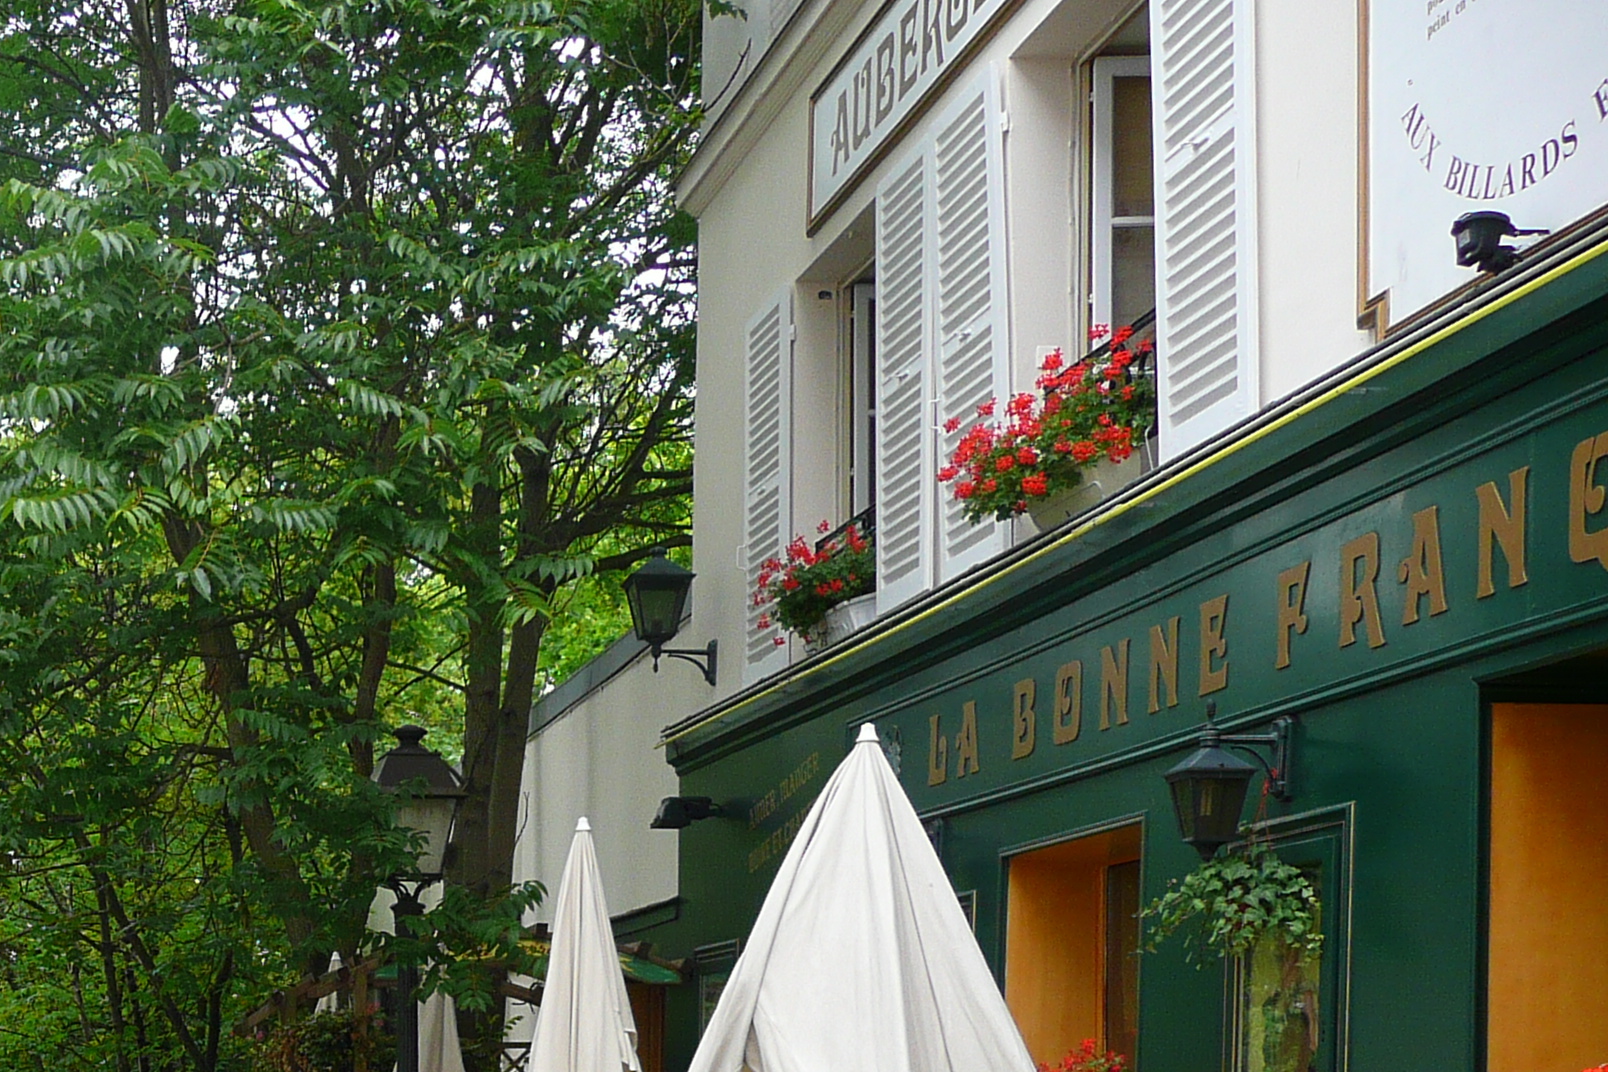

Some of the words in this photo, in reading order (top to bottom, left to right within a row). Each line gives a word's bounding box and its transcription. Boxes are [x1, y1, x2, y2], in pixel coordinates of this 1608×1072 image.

[830, 0, 987, 177] AUBERG
[1401, 103, 1441, 172] AUX
[1443, 119, 1579, 200] BILLARDS
[927, 700, 980, 787] LA
[1011, 594, 1229, 761] BONNE
